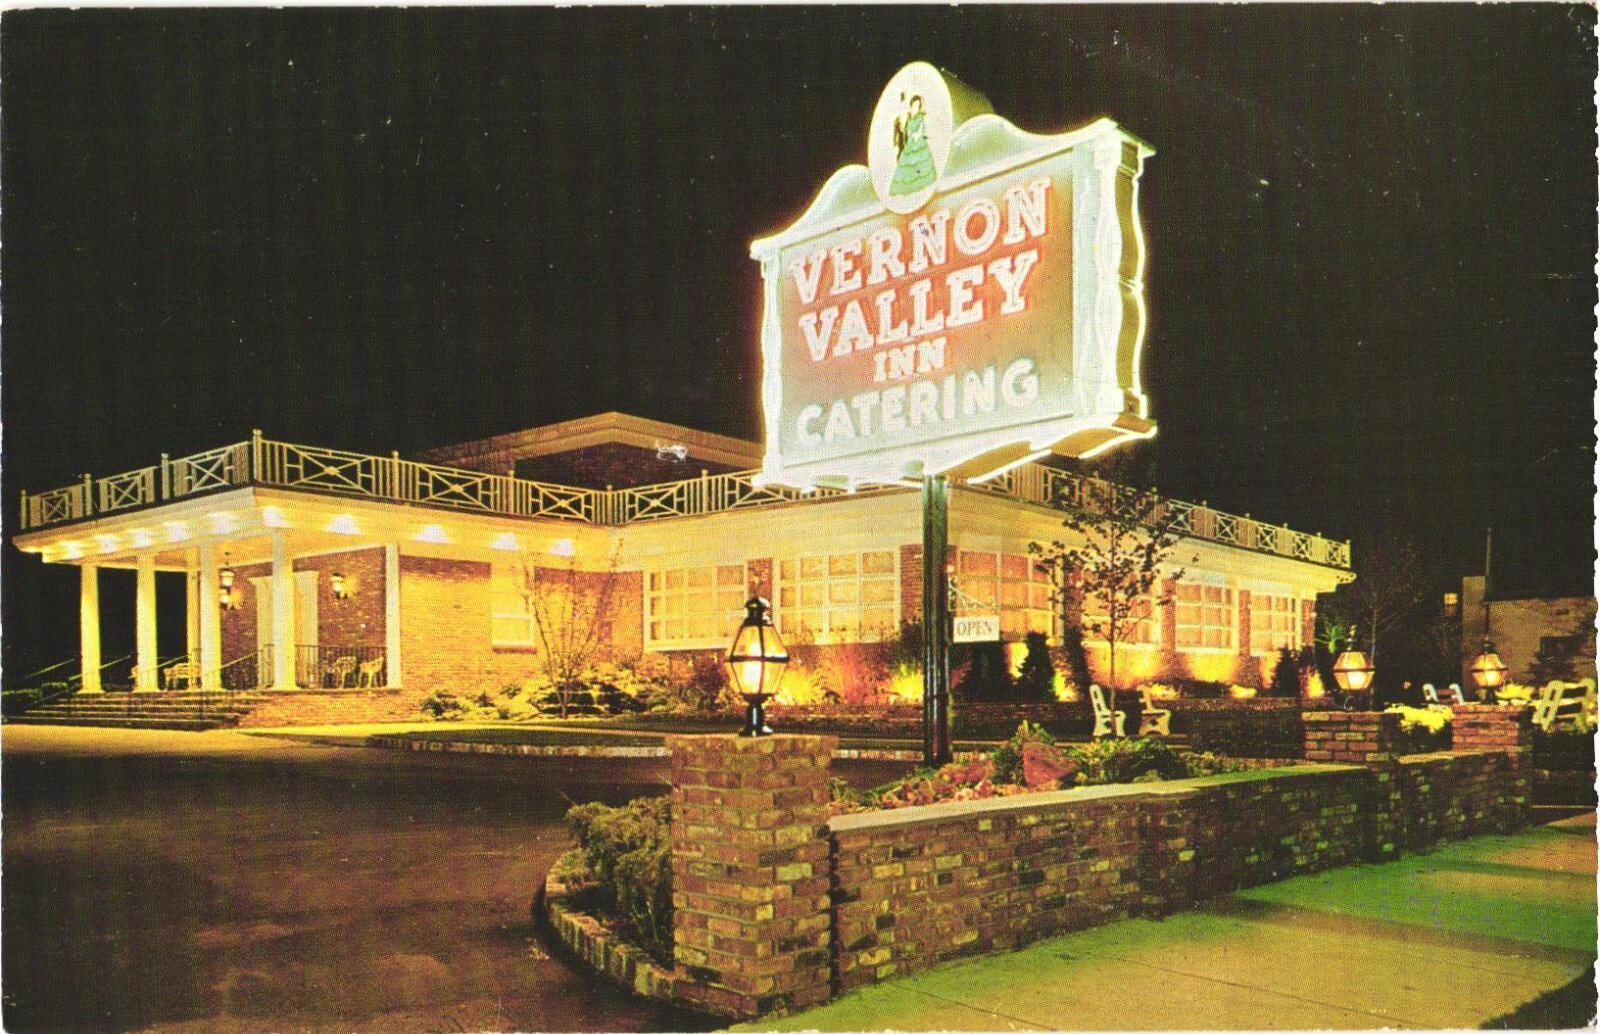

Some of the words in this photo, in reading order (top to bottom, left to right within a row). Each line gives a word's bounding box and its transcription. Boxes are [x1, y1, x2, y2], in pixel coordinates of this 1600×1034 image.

[790, 177, 1051, 304] VERNON
[798, 249, 1039, 362] VALLEY
[796, 358, 1040, 447] CATERING
[873, 337, 947, 383] INN
[956, 620, 993, 637] OPEN
